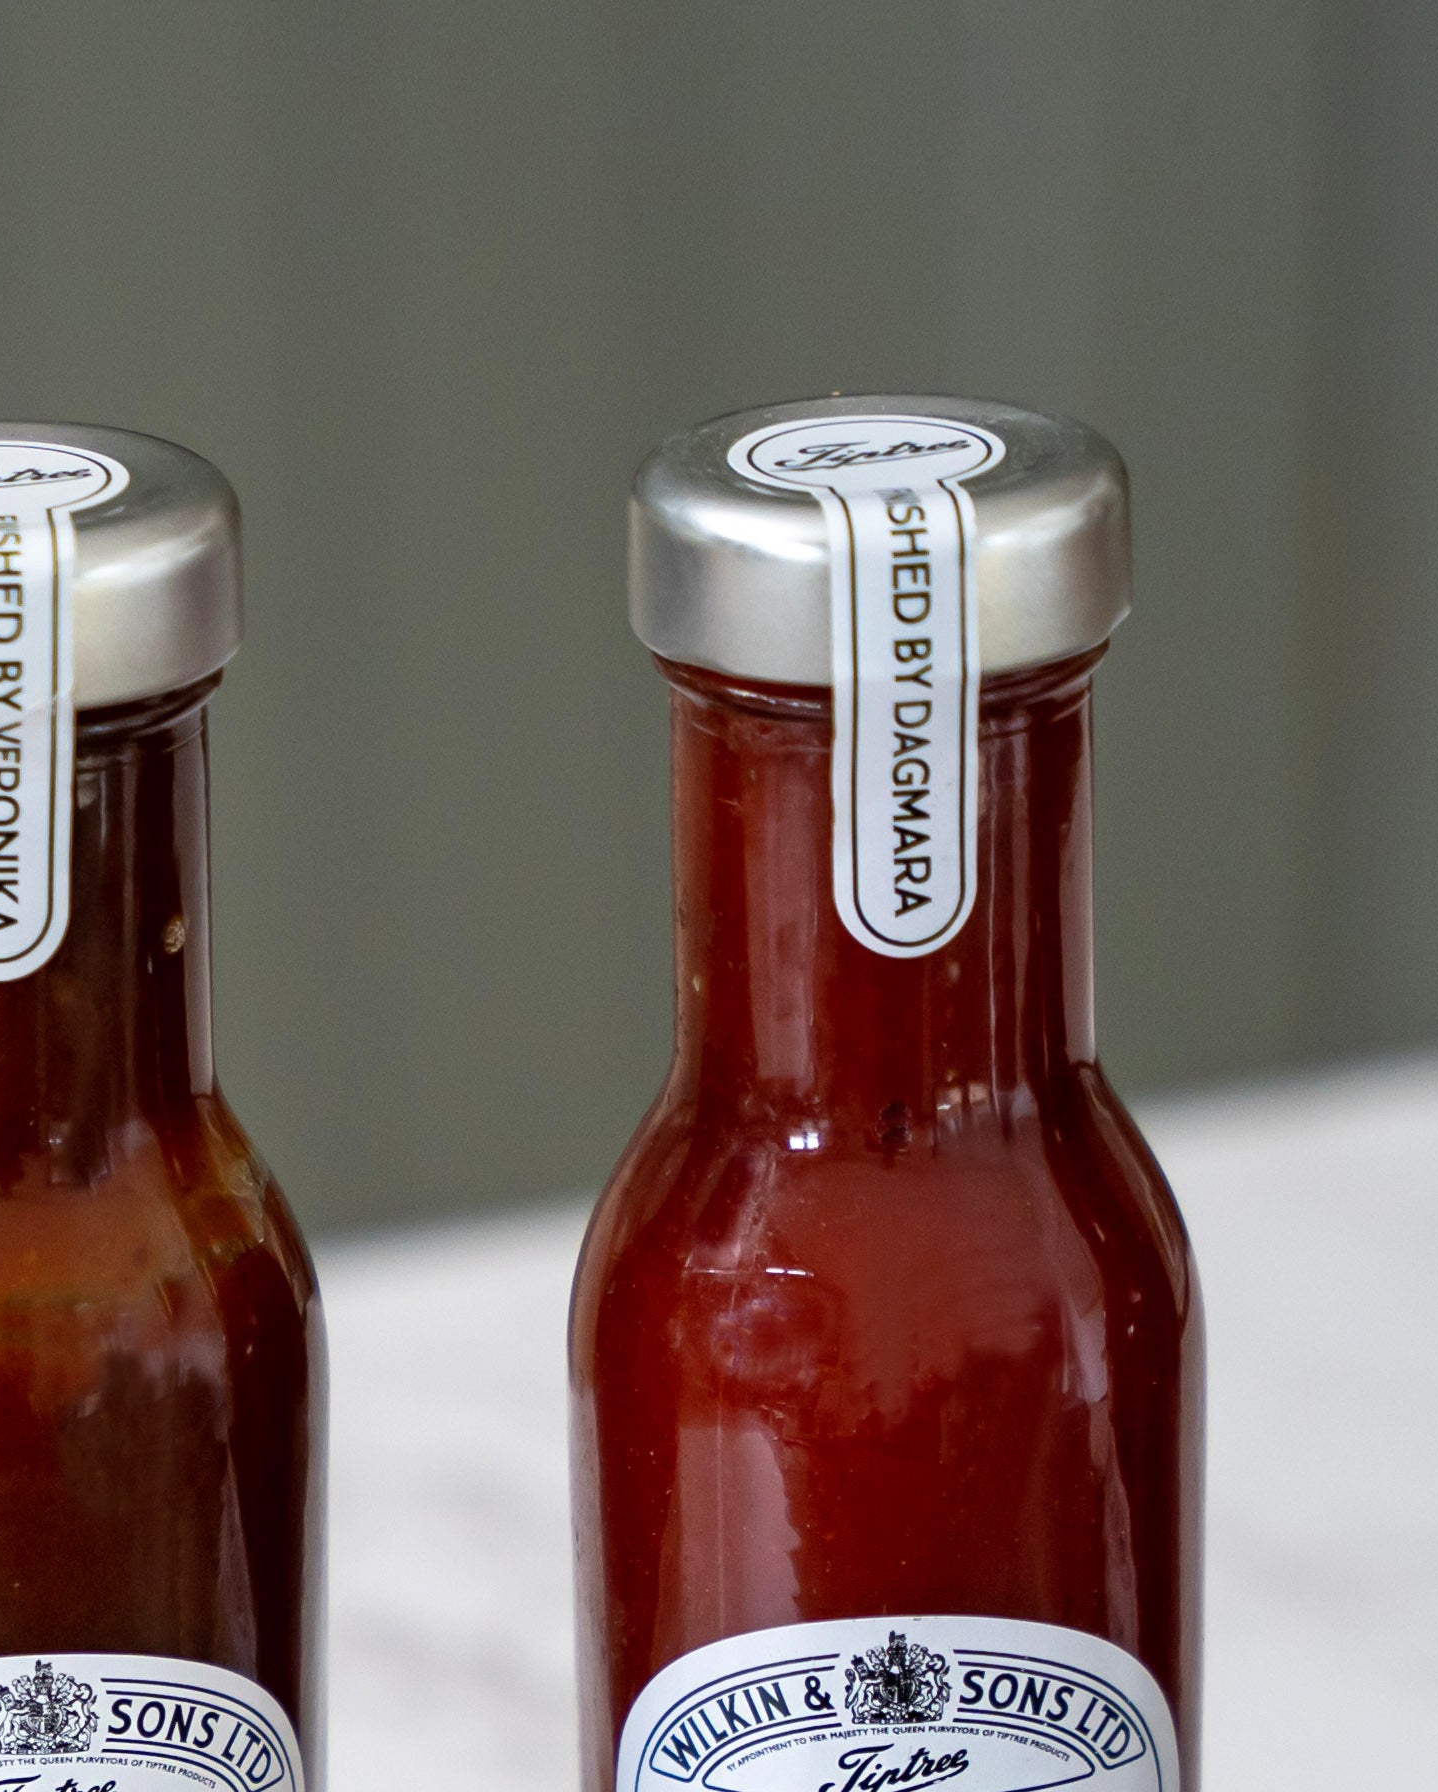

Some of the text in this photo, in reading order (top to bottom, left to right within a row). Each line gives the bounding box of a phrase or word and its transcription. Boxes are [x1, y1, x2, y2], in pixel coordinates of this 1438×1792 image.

[769, 440, 971, 472] Tiptree
[894, 638, 933, 689] BY
[893, 702, 933, 918] DAGMARA
[108, 1699, 218, 1749] SONS
[222, 1721, 272, 1785] LTD
[662, 1670, 1132, 1773] WILKIN & SONS LTD
[737, 1740, 792, 1767] APPOINTMENT
[794, 1738, 807, 1746] TO
[809, 1734, 827, 1743] HER
[830, 1729, 868, 1740] MAJESTY
[871, 1727, 889, 1735] THE
[892, 1726, 925, 1735] QUEEN
[983, 1729, 995, 1737] OF
[18, 1757, 36, 1765] THE
[40, 1756, 73, 1765] QUEEN
[131, 1759, 143, 1767] OF
